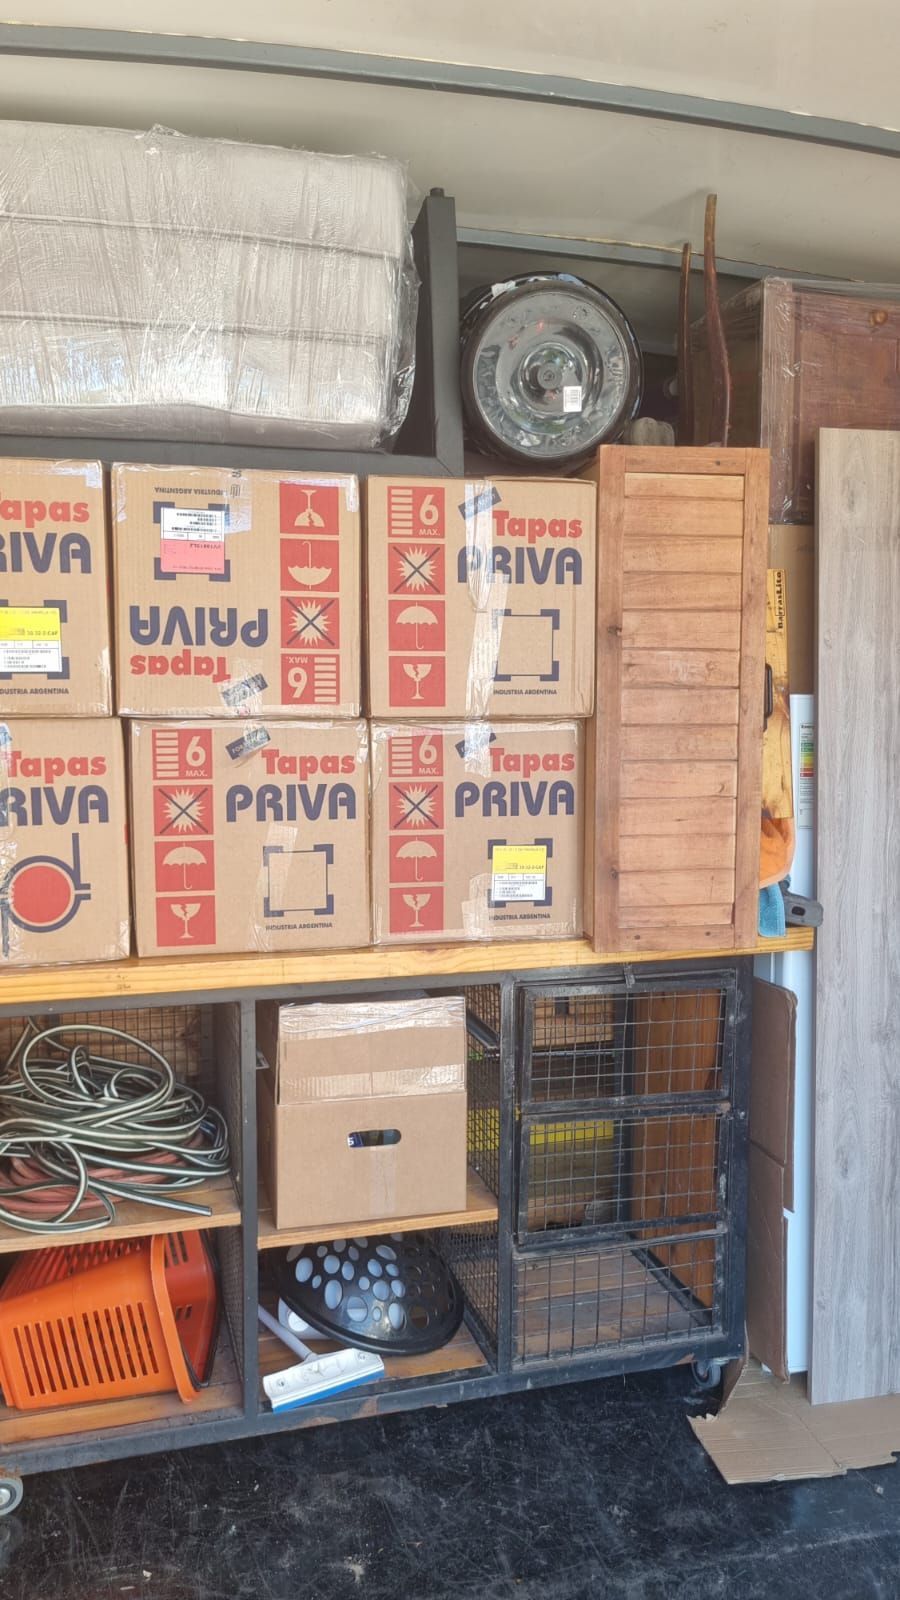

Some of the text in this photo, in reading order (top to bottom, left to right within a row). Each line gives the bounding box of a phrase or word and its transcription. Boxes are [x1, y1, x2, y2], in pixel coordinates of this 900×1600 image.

[0, 499, 90, 529] apas
[419, 494, 439, 526] 6
[418, 528, 440, 536] MAX.
[492, 510, 582, 544] Tapas
[457, 545, 582, 585] PRIVA
[129, 605, 268, 648] PRIVA
[130, 648, 231, 684] Tapas
[287, 667, 308, 698] 6
[186, 735, 206, 767] 6
[419, 732, 438, 765] 6
[490, 747, 575, 778] Tapas
[7, 751, 107, 784] Tapas
[185, 769, 208, 777] MAX.
[262, 749, 356, 781] Tapas
[418, 767, 440, 775] MAX.
[226, 782, 356, 822] PRIVA
[455, 780, 575, 817] PRIVA
